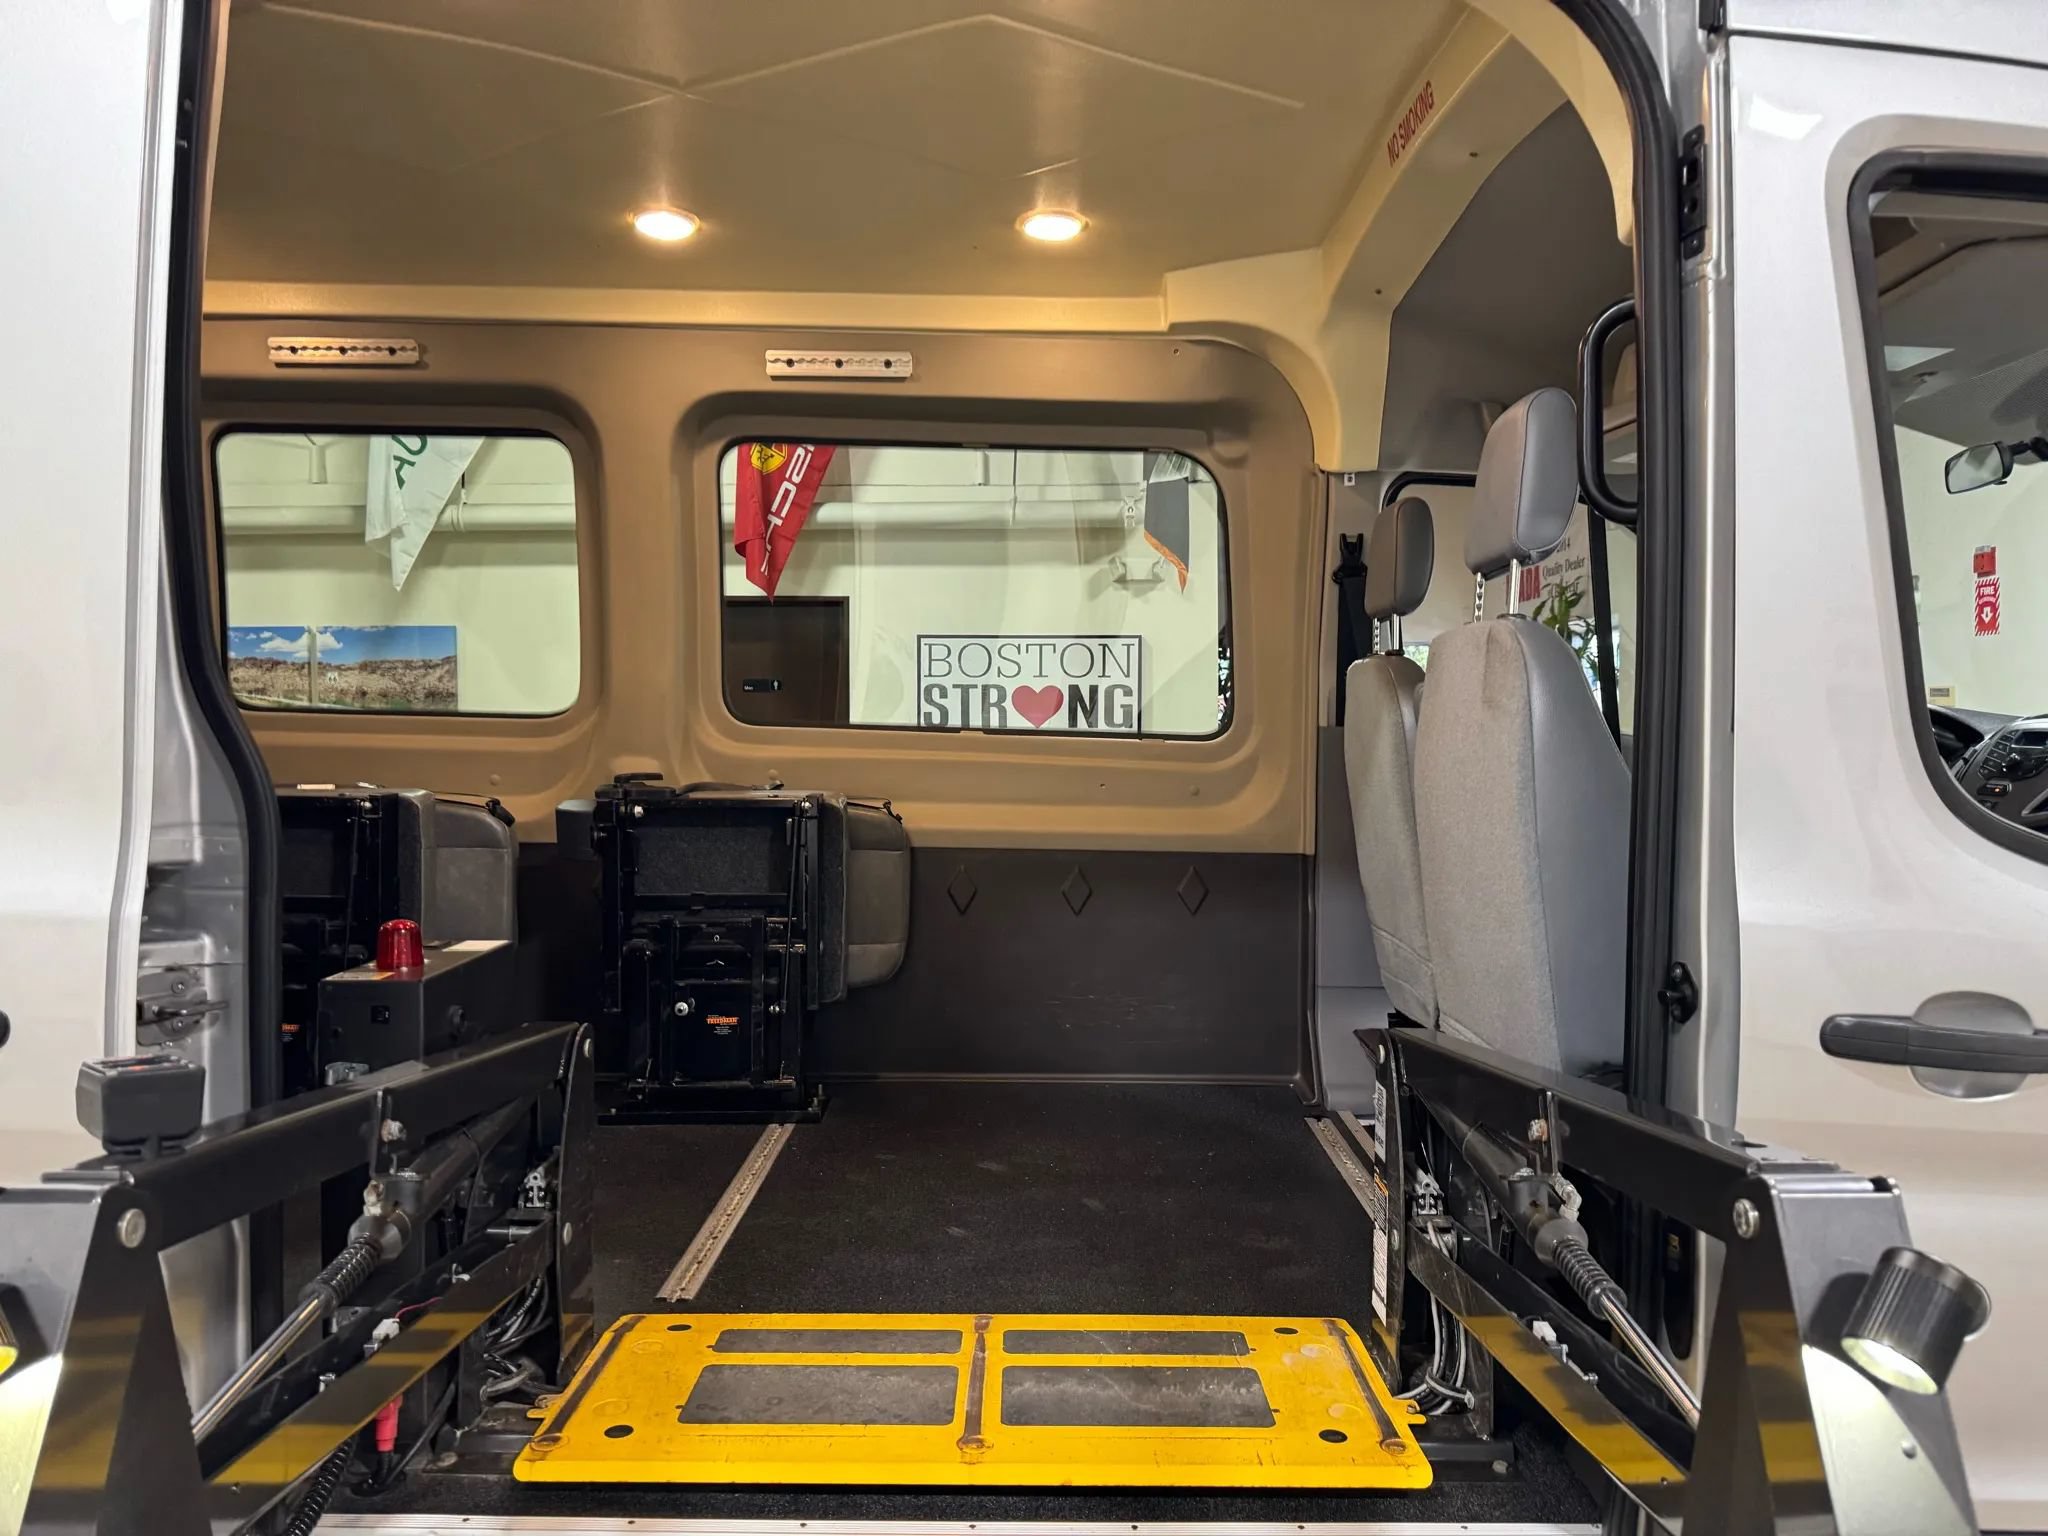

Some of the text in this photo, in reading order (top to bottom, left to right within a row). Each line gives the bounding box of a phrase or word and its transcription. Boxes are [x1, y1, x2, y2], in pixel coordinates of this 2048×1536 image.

[1387, 80, 1434, 168] NO SMOKING
[1565, 556, 1585, 572] Dealer
[1980, 586, 1995, 596] FIRE
[923, 642, 1136, 679] BOSTON
